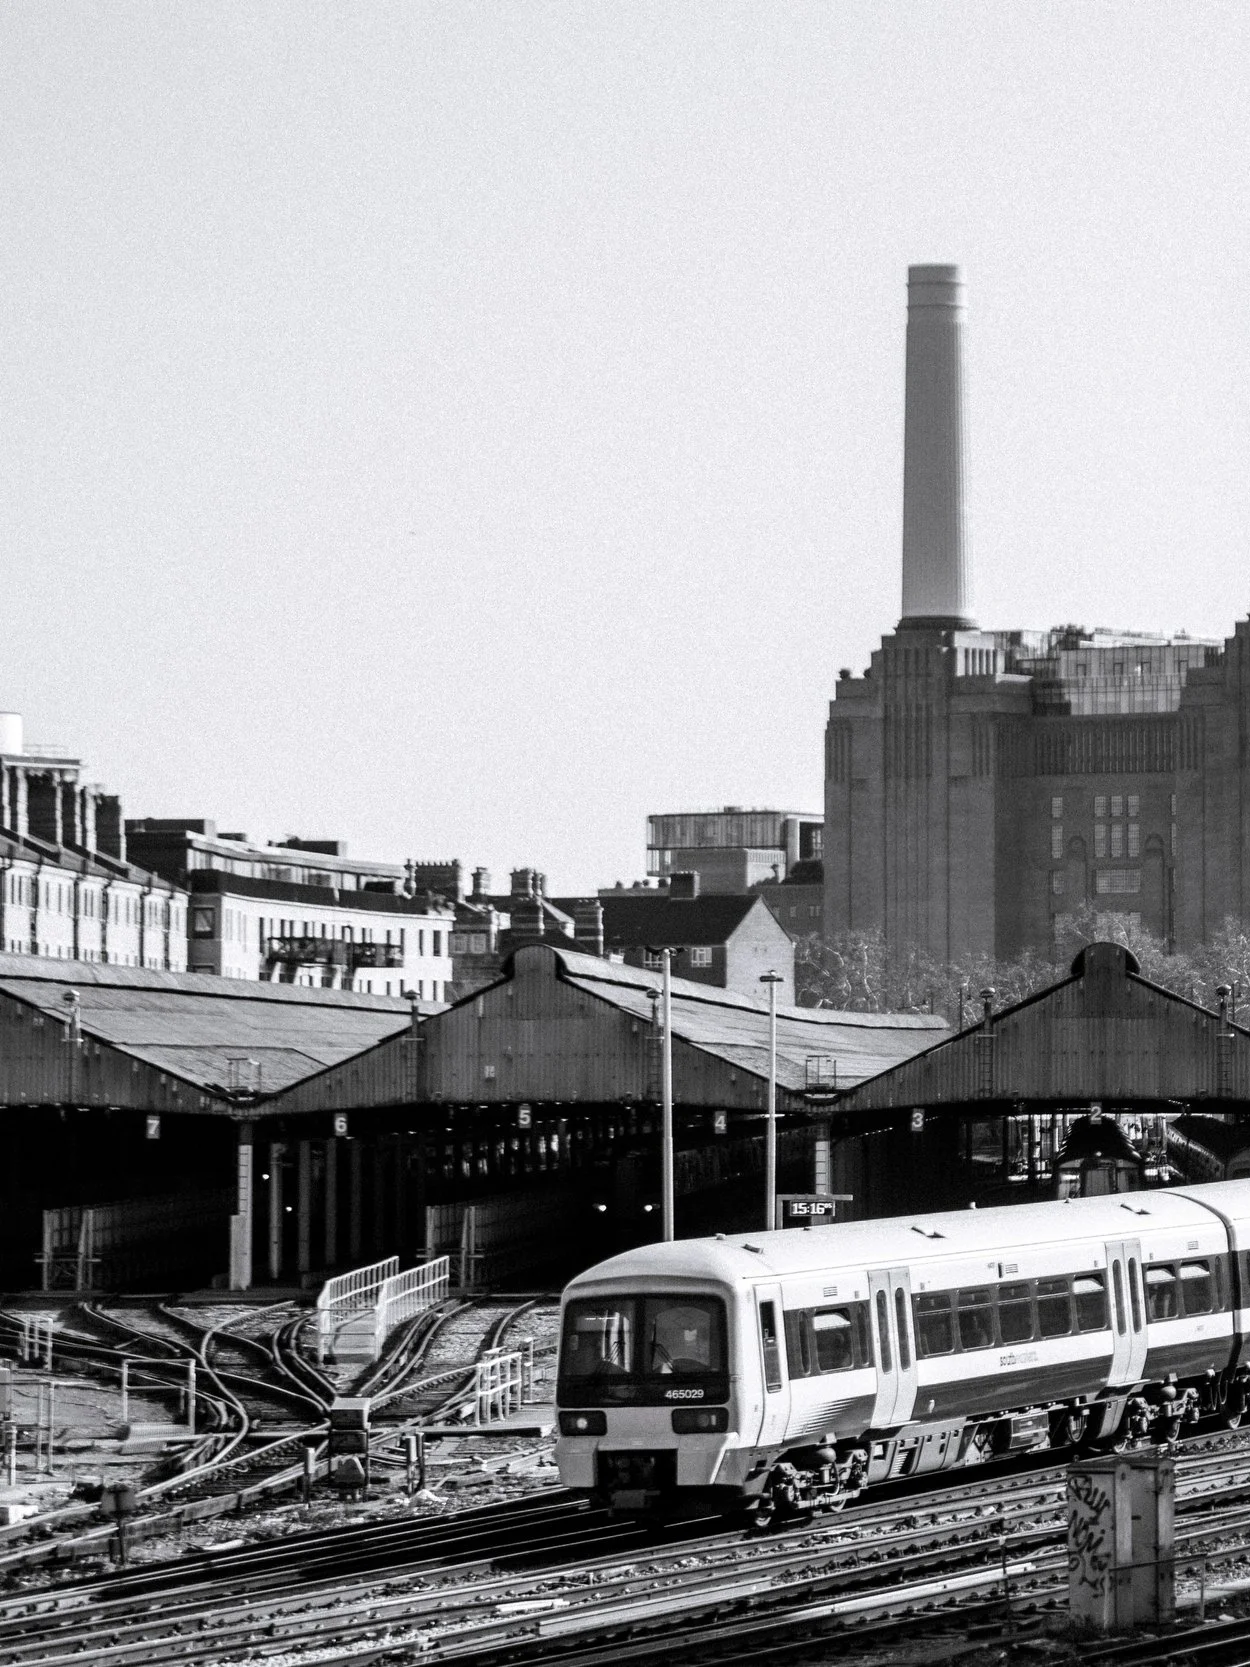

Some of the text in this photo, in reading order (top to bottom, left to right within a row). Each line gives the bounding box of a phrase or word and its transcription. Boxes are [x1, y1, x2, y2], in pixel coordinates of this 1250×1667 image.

[519, 1109, 530, 1125] 5
[912, 1112, 923, 1128] 3
[1091, 1106, 1101, 1121] 2
[147, 1119, 160, 1134] 7
[335, 1117, 347, 1132] 6
[715, 1115, 727, 1130] 4
[665, 1389, 705, 1399] 465029
